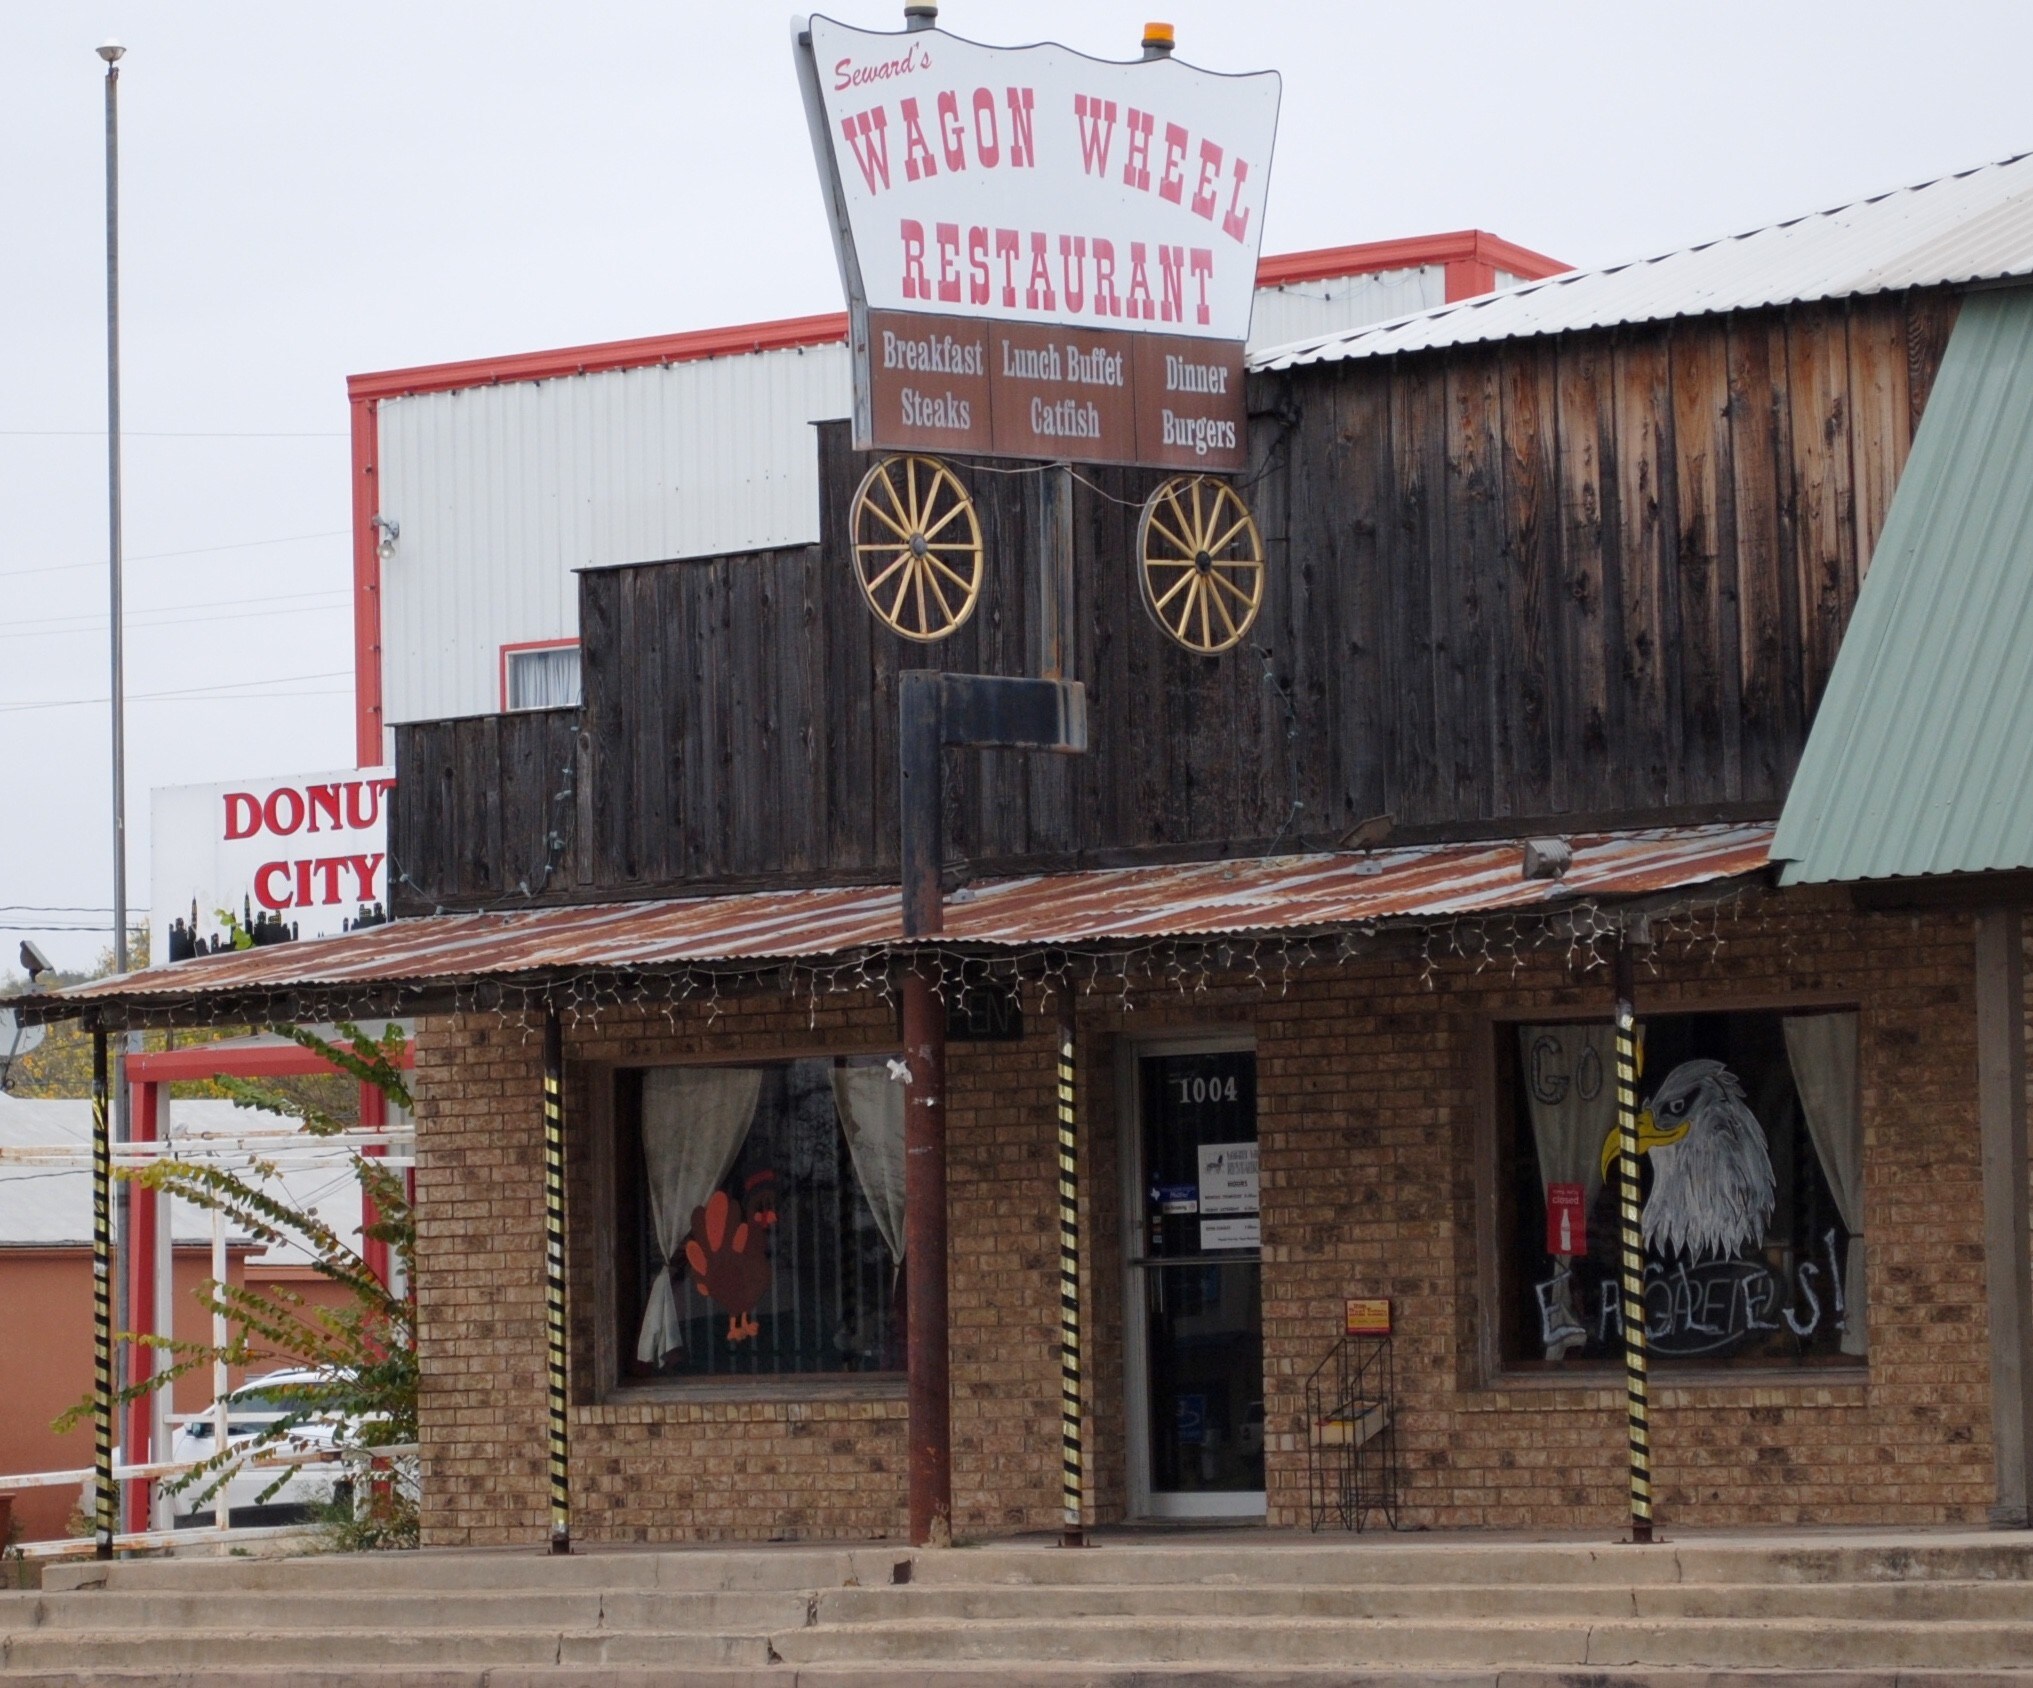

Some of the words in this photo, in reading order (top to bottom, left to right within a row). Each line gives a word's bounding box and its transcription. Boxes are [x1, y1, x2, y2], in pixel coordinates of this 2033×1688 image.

[834, 42, 931, 92] Seward's
[841, 87, 1035, 196] WAGON
[1074, 93, 1250, 244] WHEEL
[900, 218, 1213, 325] RESTAURANT
[883, 330, 983, 377] Breakfast
[1002, 340, 1062, 381] Lunch
[1067, 344, 1124, 387] Buffet
[1166, 355, 1228, 395] Dinner
[901, 387, 971, 430] Steaks
[1031, 396, 1100, 438] Catfish
[1162, 409, 1236, 455] Burgers
[254, 853, 385, 910] CITY
[1179, 1076, 1238, 1103] 1004
[1530, 1034, 1603, 1105] GO
